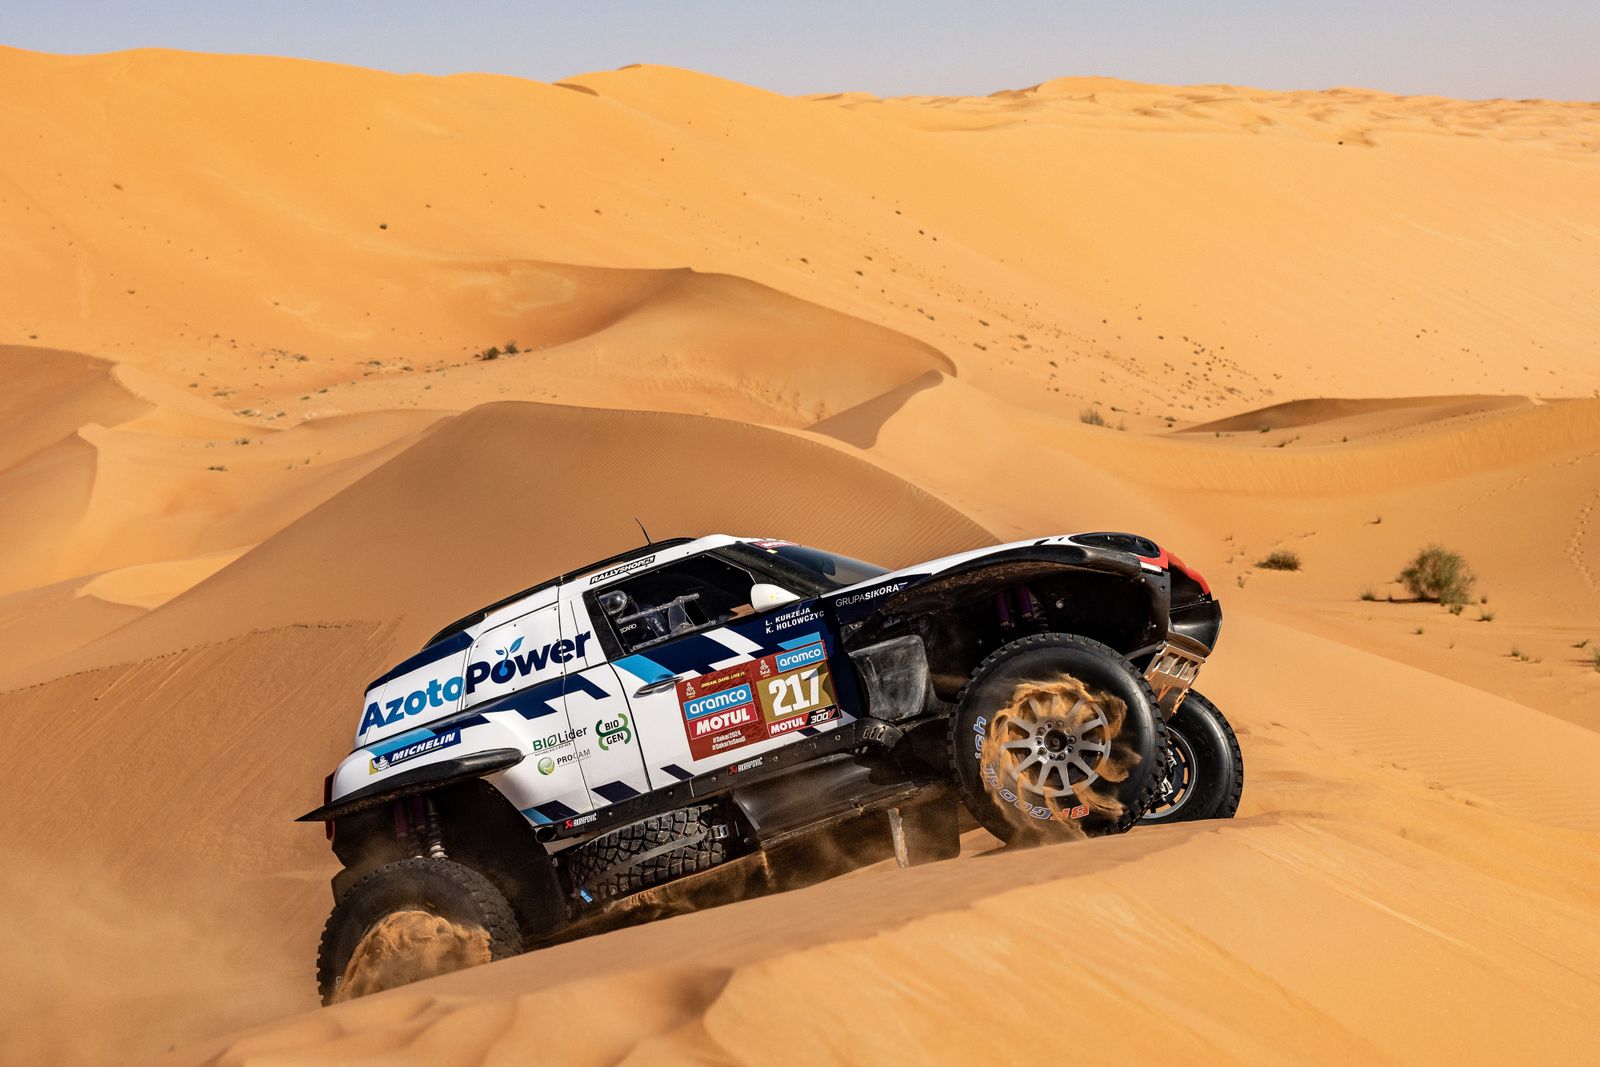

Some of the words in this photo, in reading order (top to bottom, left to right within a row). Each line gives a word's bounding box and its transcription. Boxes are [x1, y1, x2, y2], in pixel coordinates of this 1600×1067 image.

[775, 607, 811, 623] KURZEJA
[776, 611, 825, 631] HOLOWCZYC
[779, 649, 821, 667] aramco
[689, 689, 747, 715] aramco
[768, 668, 820, 717] 217
[604, 720, 620, 731] BIO
[696, 708, 750, 735] MOTUL
[770, 717, 805, 734] MOTUL
[391, 731, 456, 763] MICHELIN
[606, 732, 624, 745] GEN
